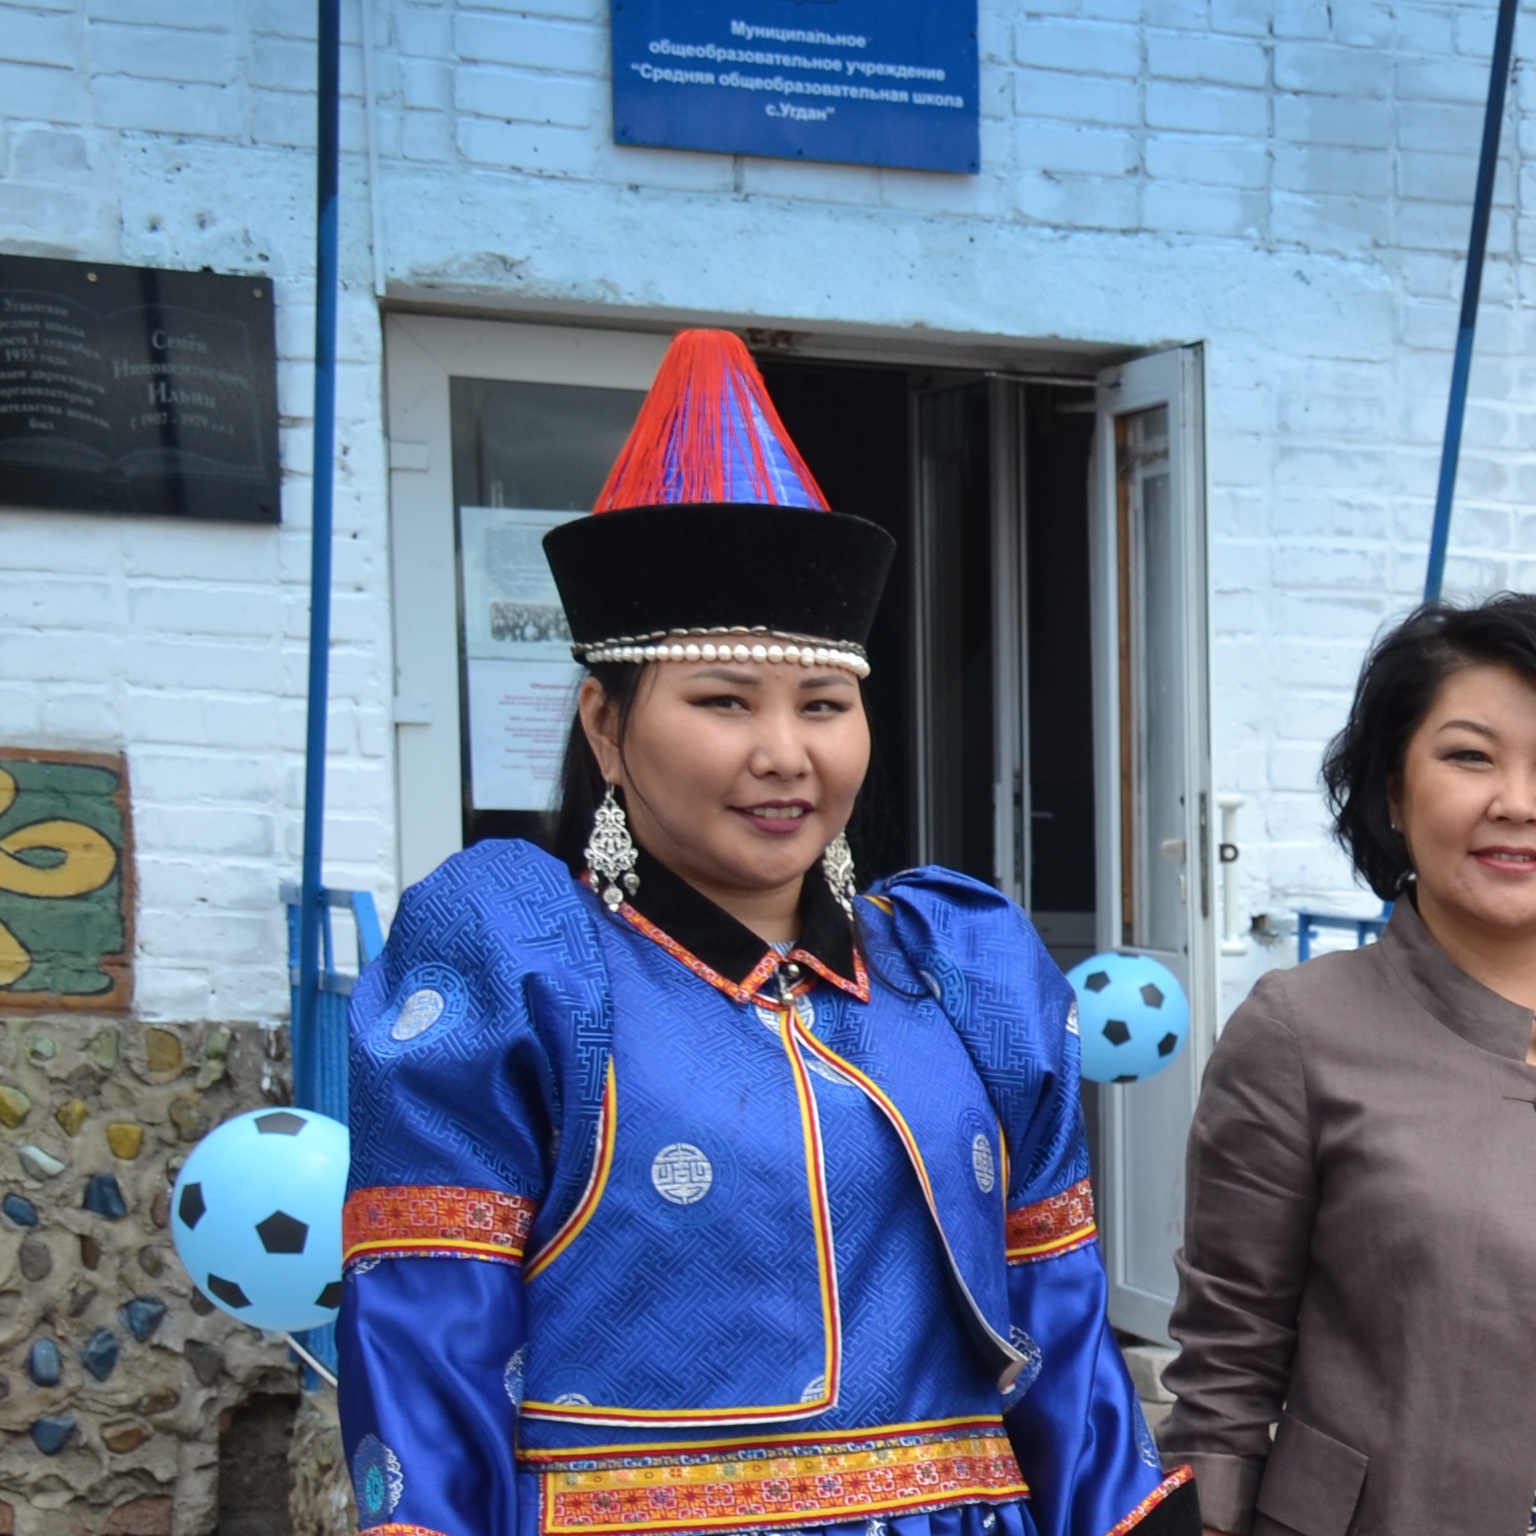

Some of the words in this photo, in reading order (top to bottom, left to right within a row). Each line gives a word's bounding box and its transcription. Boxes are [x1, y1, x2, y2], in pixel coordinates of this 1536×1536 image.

[731, 20, 867, 49] Муниципальное
[649, 39, 843, 73] общеобразовательное
[845, 59, 946, 82] учреждение
[718, 71, 909, 103] общеобразовательная
[912, 91, 964, 109] школа
